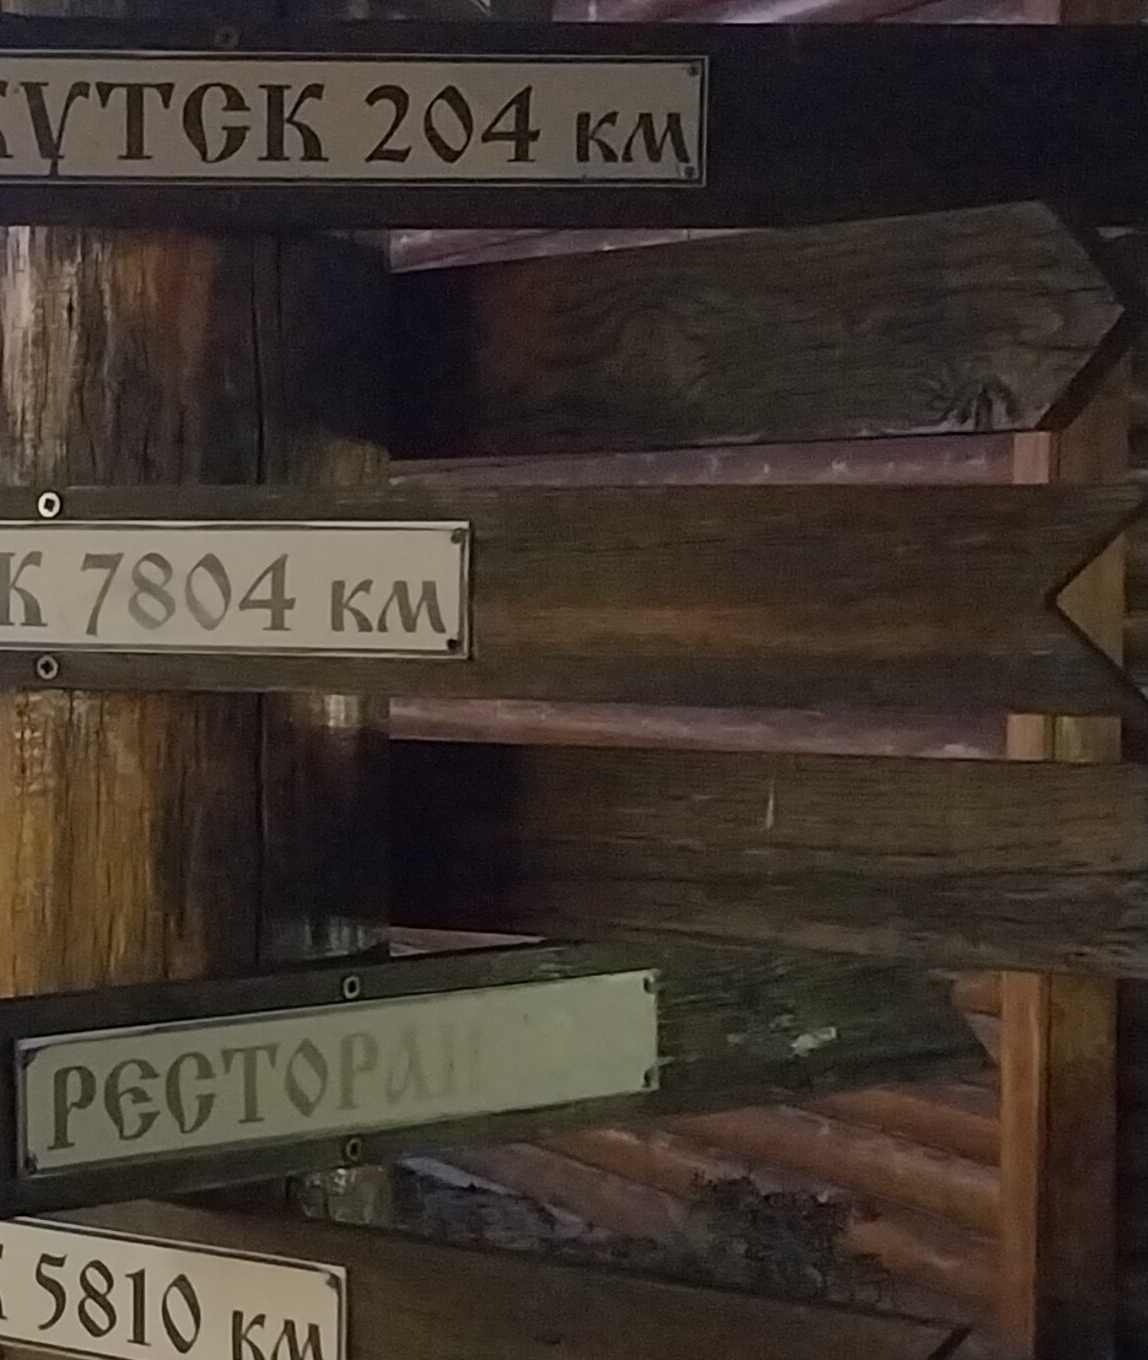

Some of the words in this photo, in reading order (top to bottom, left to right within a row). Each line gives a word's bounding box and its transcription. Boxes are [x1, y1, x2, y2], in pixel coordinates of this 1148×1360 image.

[365, 84, 542, 165] 204
[574, 111, 692, 166] км
[80, 551, 296, 637] 7804
[330, 578, 448, 635] км
[35, 1253, 203, 1355] 5810
